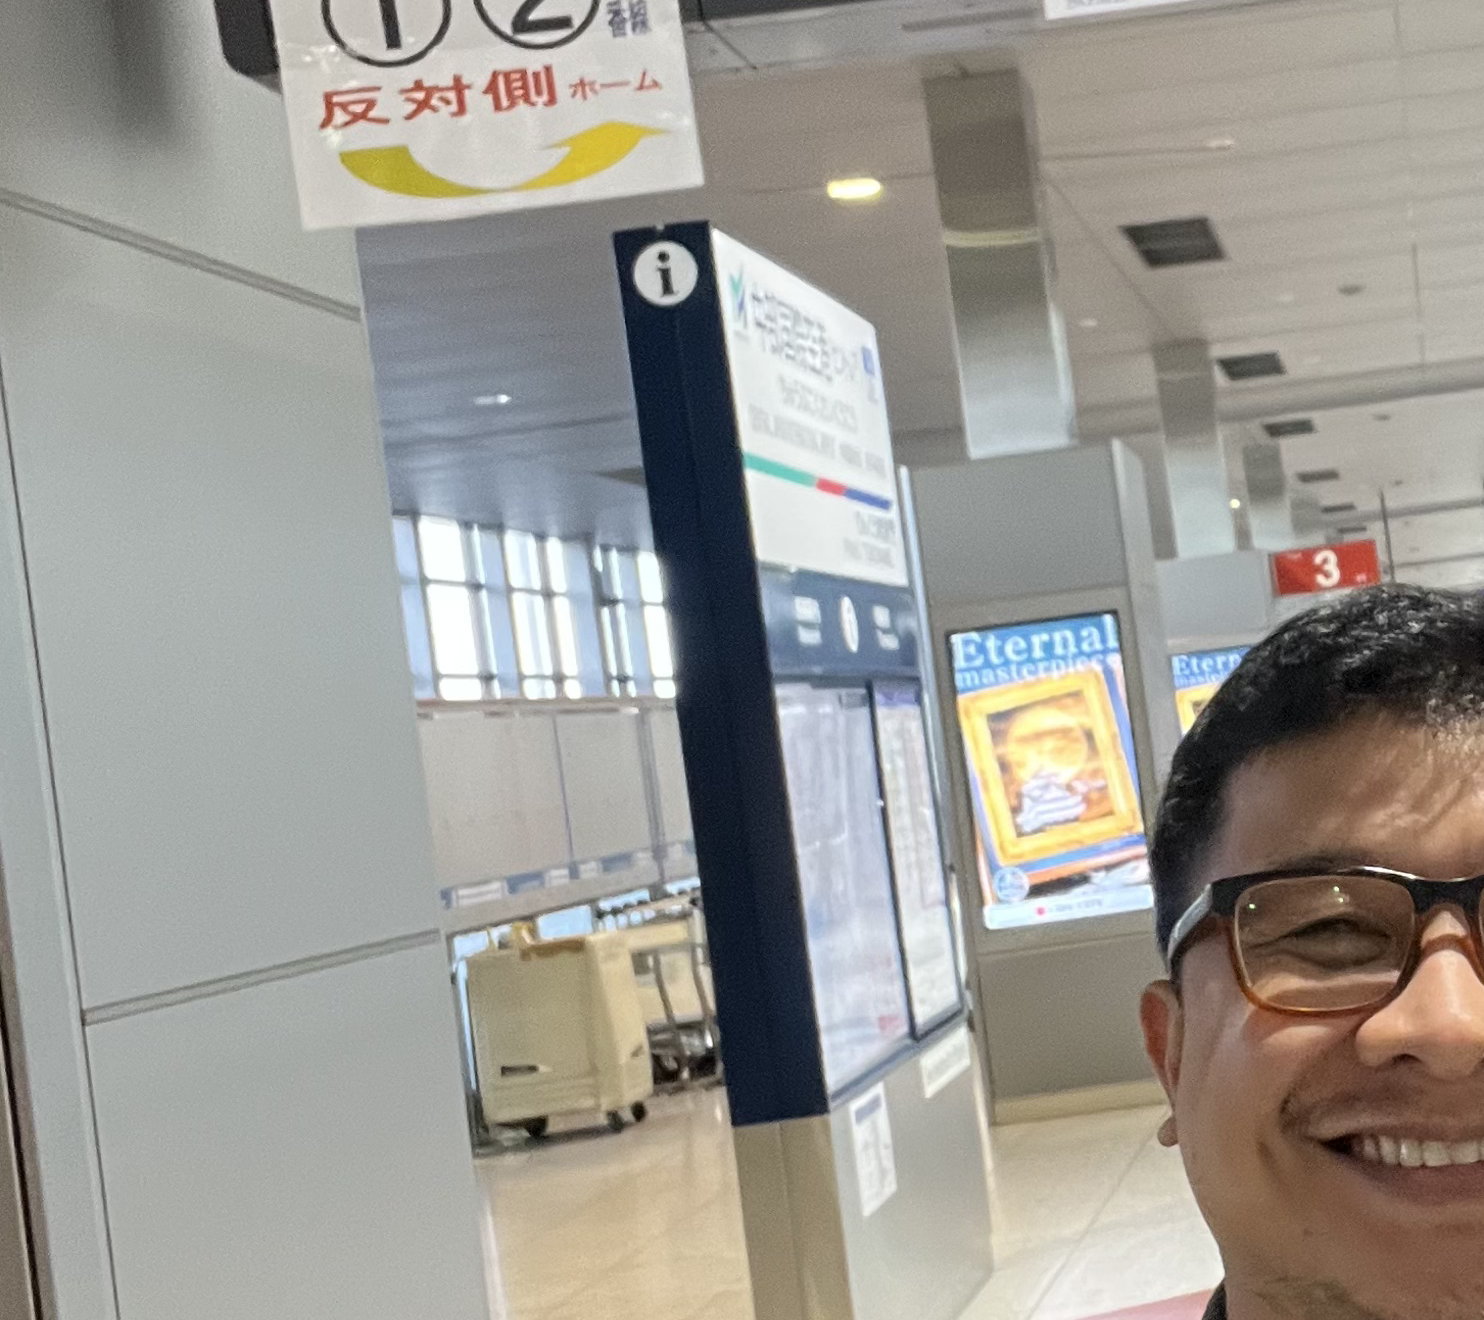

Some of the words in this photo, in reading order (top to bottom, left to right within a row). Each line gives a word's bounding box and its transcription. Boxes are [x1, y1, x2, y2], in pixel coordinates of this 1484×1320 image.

[318, 64, 664, 131] 反対側ホーム
[1313, 548, 1341, 589] 3
[953, 612, 1121, 669] Eternal
